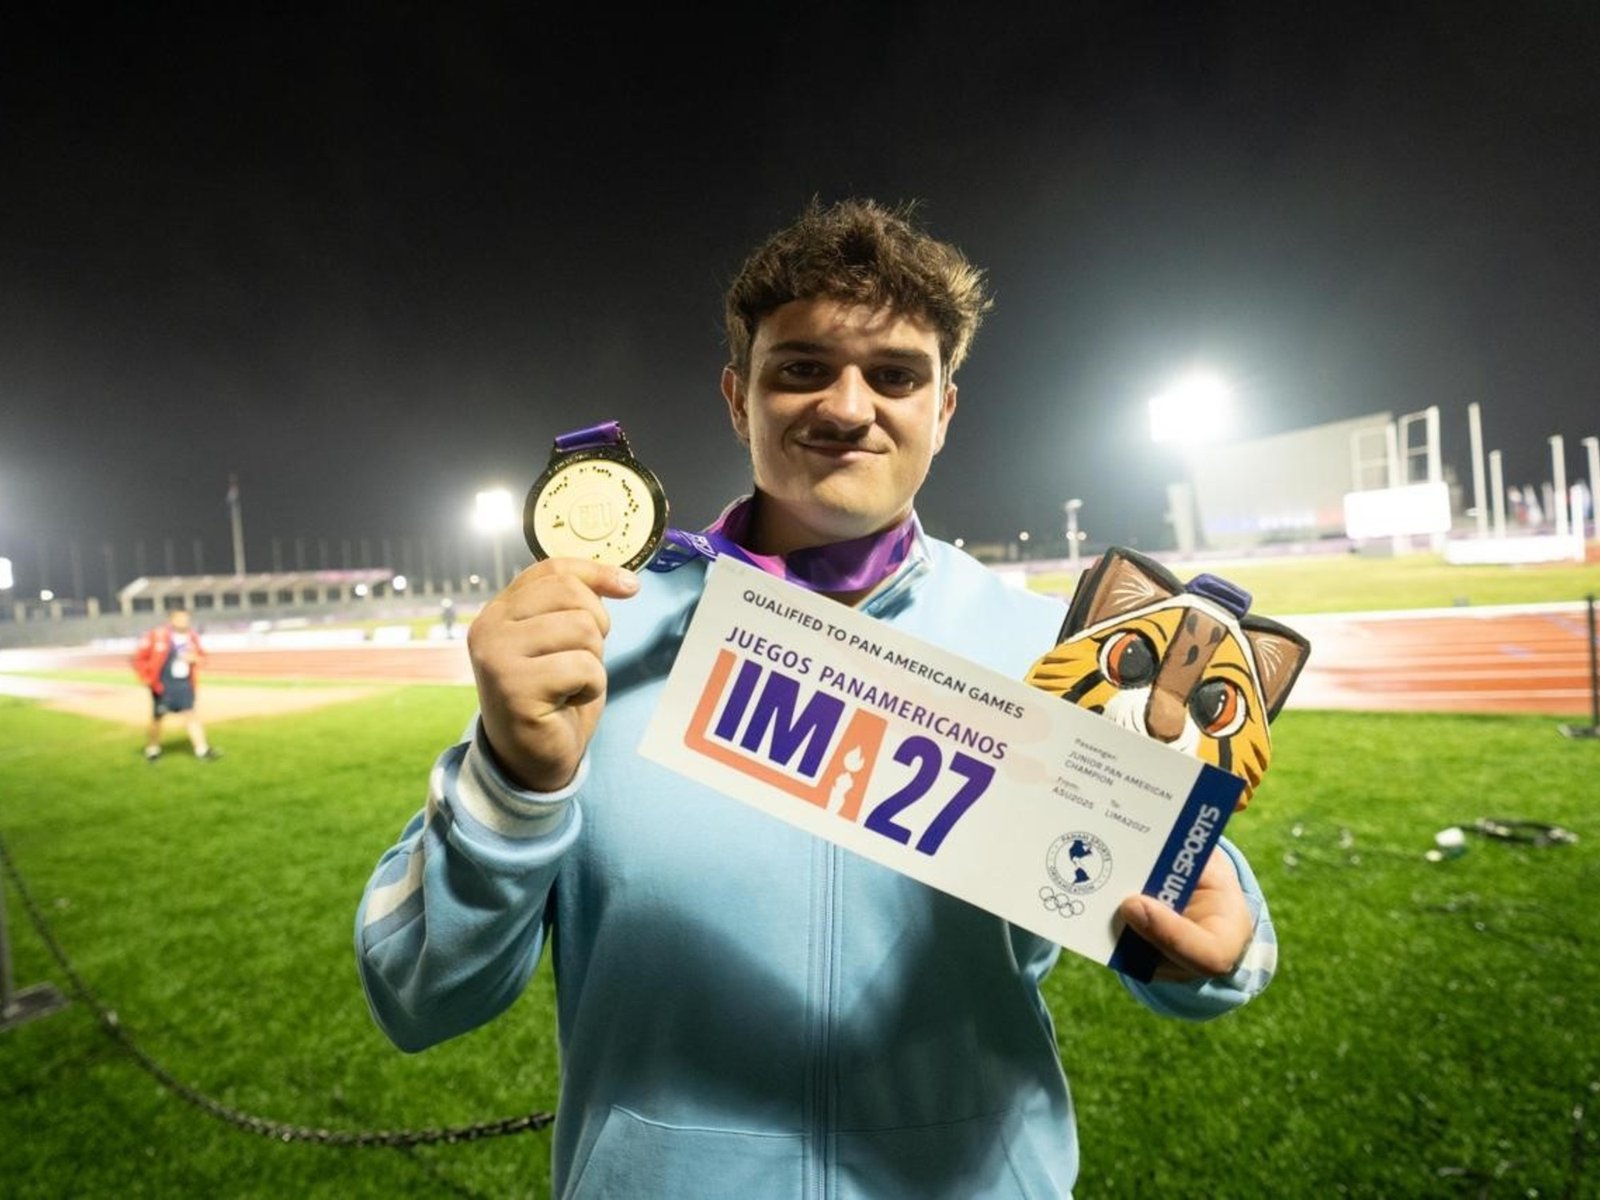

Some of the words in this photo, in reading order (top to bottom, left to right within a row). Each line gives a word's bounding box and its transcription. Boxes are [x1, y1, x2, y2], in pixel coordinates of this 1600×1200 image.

[743, 590, 823, 632] QUALIFIED
[827, 624, 847, 642] TO
[849, 635, 883, 657] PAN
[883, 650, 967, 694] AMERICAN
[968, 687, 1025, 719] GAMES
[725, 627, 813, 675] JUEGOS
[818, 666, 1009, 761] PANAMERICANOS
[683, 648, 888, 824] LIMA
[864, 735, 996, 857] 27
[1064, 759, 1114, 786] CHAMPION
[1069, 751, 1103, 770] JUNIOR
[1104, 765, 1123, 779] PAN
[1123, 775, 1173, 801] AMERICAN
[1052, 786, 1094, 810] ASU2025
[1104, 809, 1151, 834] LIMA2027
[1172, 803, 1221, 878] SPORTS
